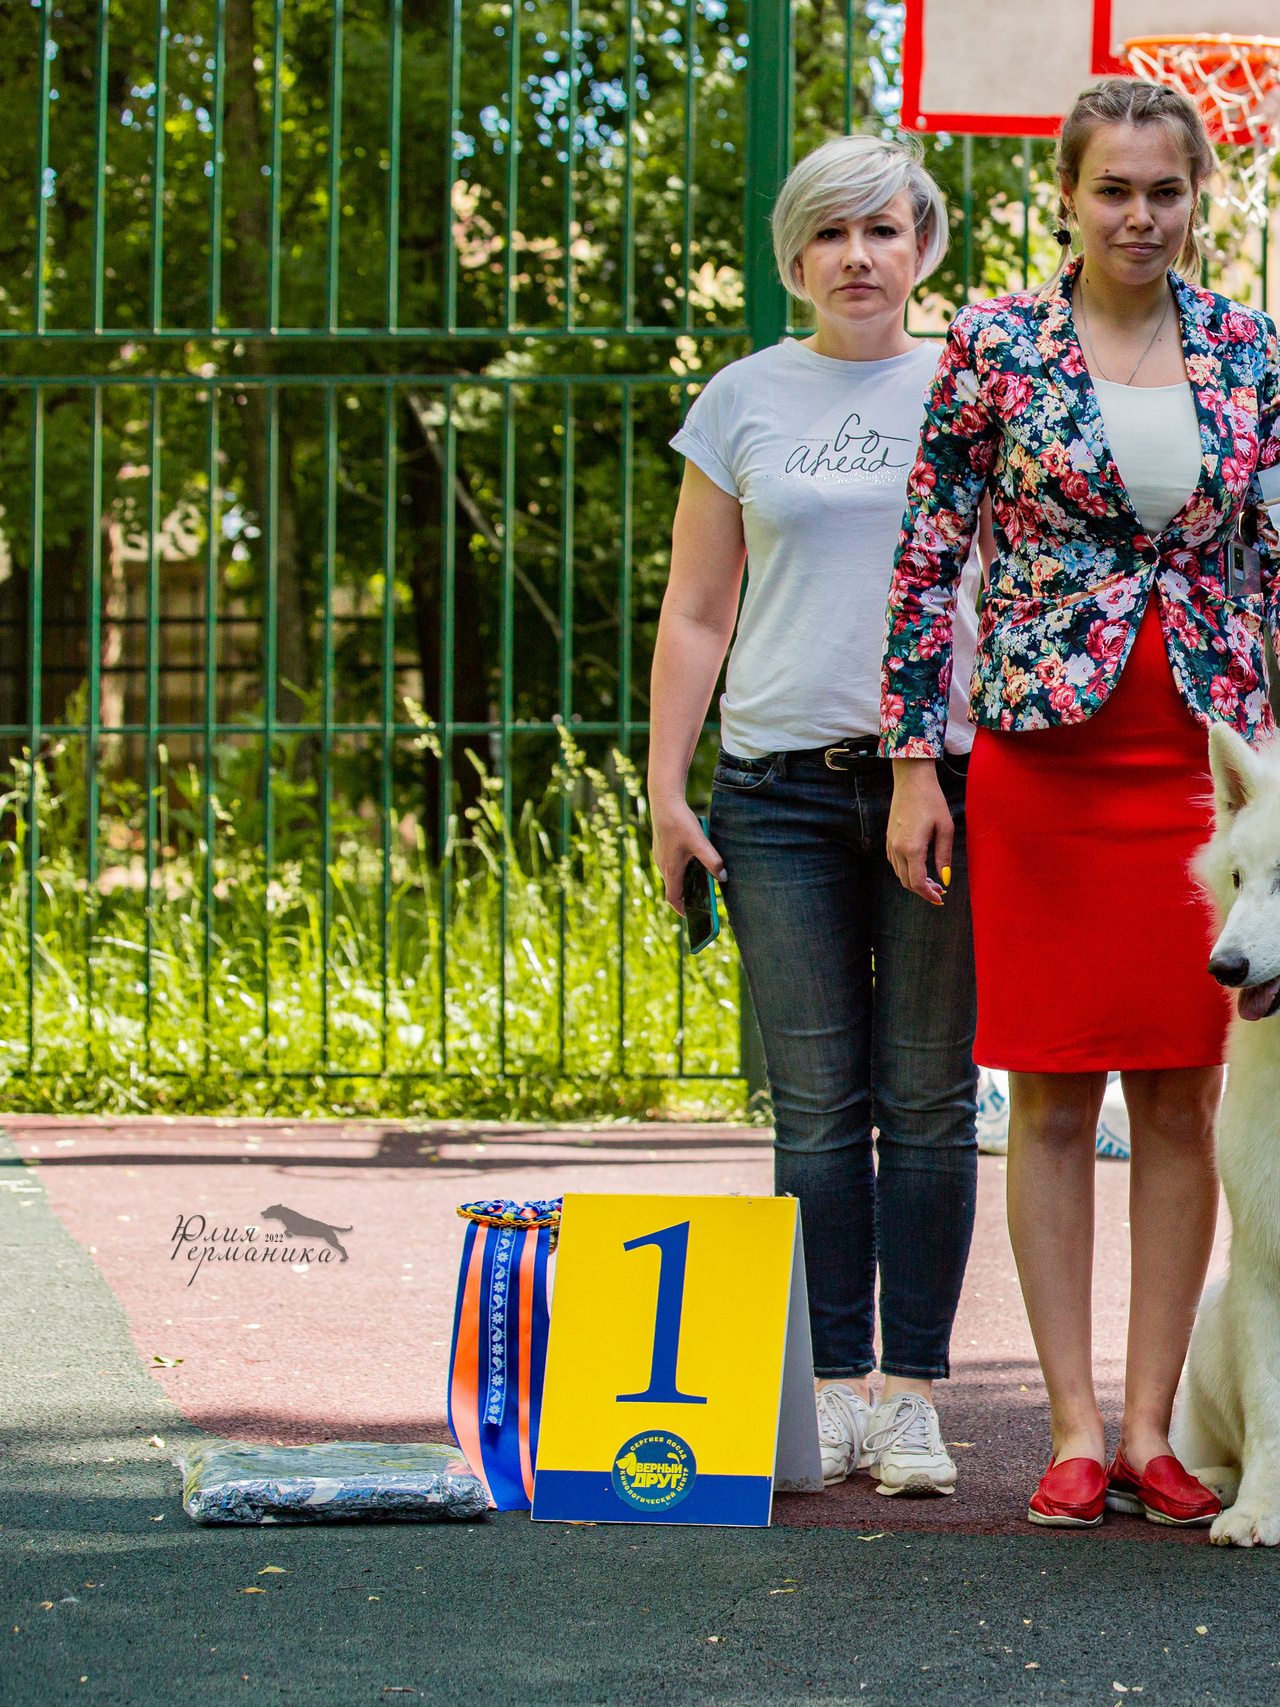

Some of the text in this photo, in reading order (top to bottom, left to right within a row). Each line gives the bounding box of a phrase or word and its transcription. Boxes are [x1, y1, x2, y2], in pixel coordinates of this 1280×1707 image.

[834, 413, 912, 454] Go
[616, 1220, 707, 1404] 1
[630, 1436, 687, 1460] СЕРГИЕВ ПОСАД
[631, 1472, 682, 1488] ДРУГ
[676, 1467, 689, 1492] ЦЕНТР
